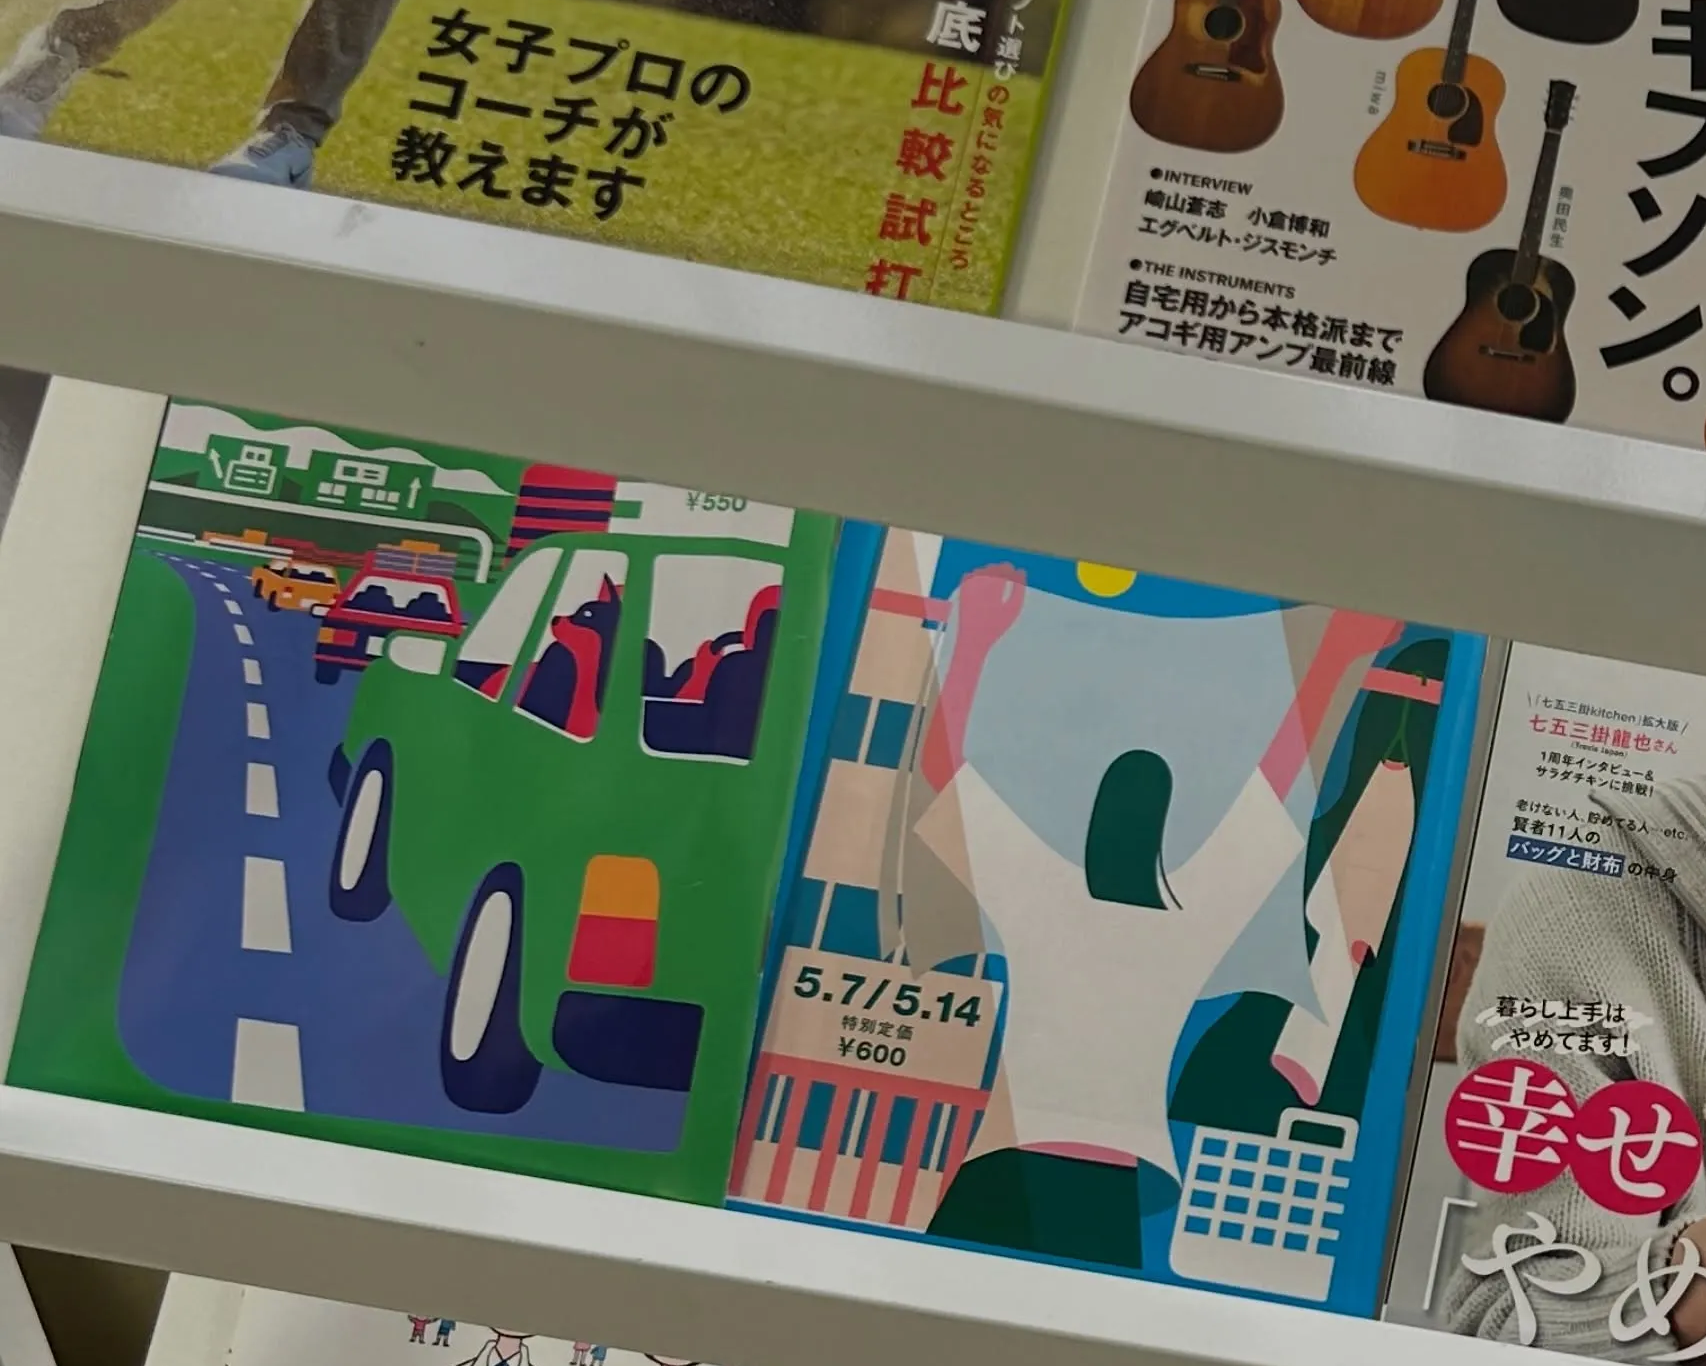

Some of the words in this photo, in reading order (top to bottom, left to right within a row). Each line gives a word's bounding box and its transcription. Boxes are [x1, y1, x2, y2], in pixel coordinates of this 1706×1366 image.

[428, 8, 751, 115] 女子プロの
[409, 71, 676, 160] コーチが
[391, 124, 646, 221] 教えます
[1163, 169, 1254, 196] INTERVIEW
[1137, 215, 1338, 268] エグベルト・ジスモンチ
[1144, 259, 1175, 279] THE
[1177, 264, 1297, 300] INSTRUMENTS
[1123, 278, 1405, 354] 自宅用から本格派まで
[1117, 310, 1398, 387] アコギ用アンプ最前線
[1512, 816, 1601, 846] 賢者11人の
[840, 1014, 914, 1042] 特別定価
[1495, 996, 1626, 1024] 暮らし上手は
[837, 1036, 907, 1068] ¥600
[1509, 1029, 1631, 1055] やめてます!
